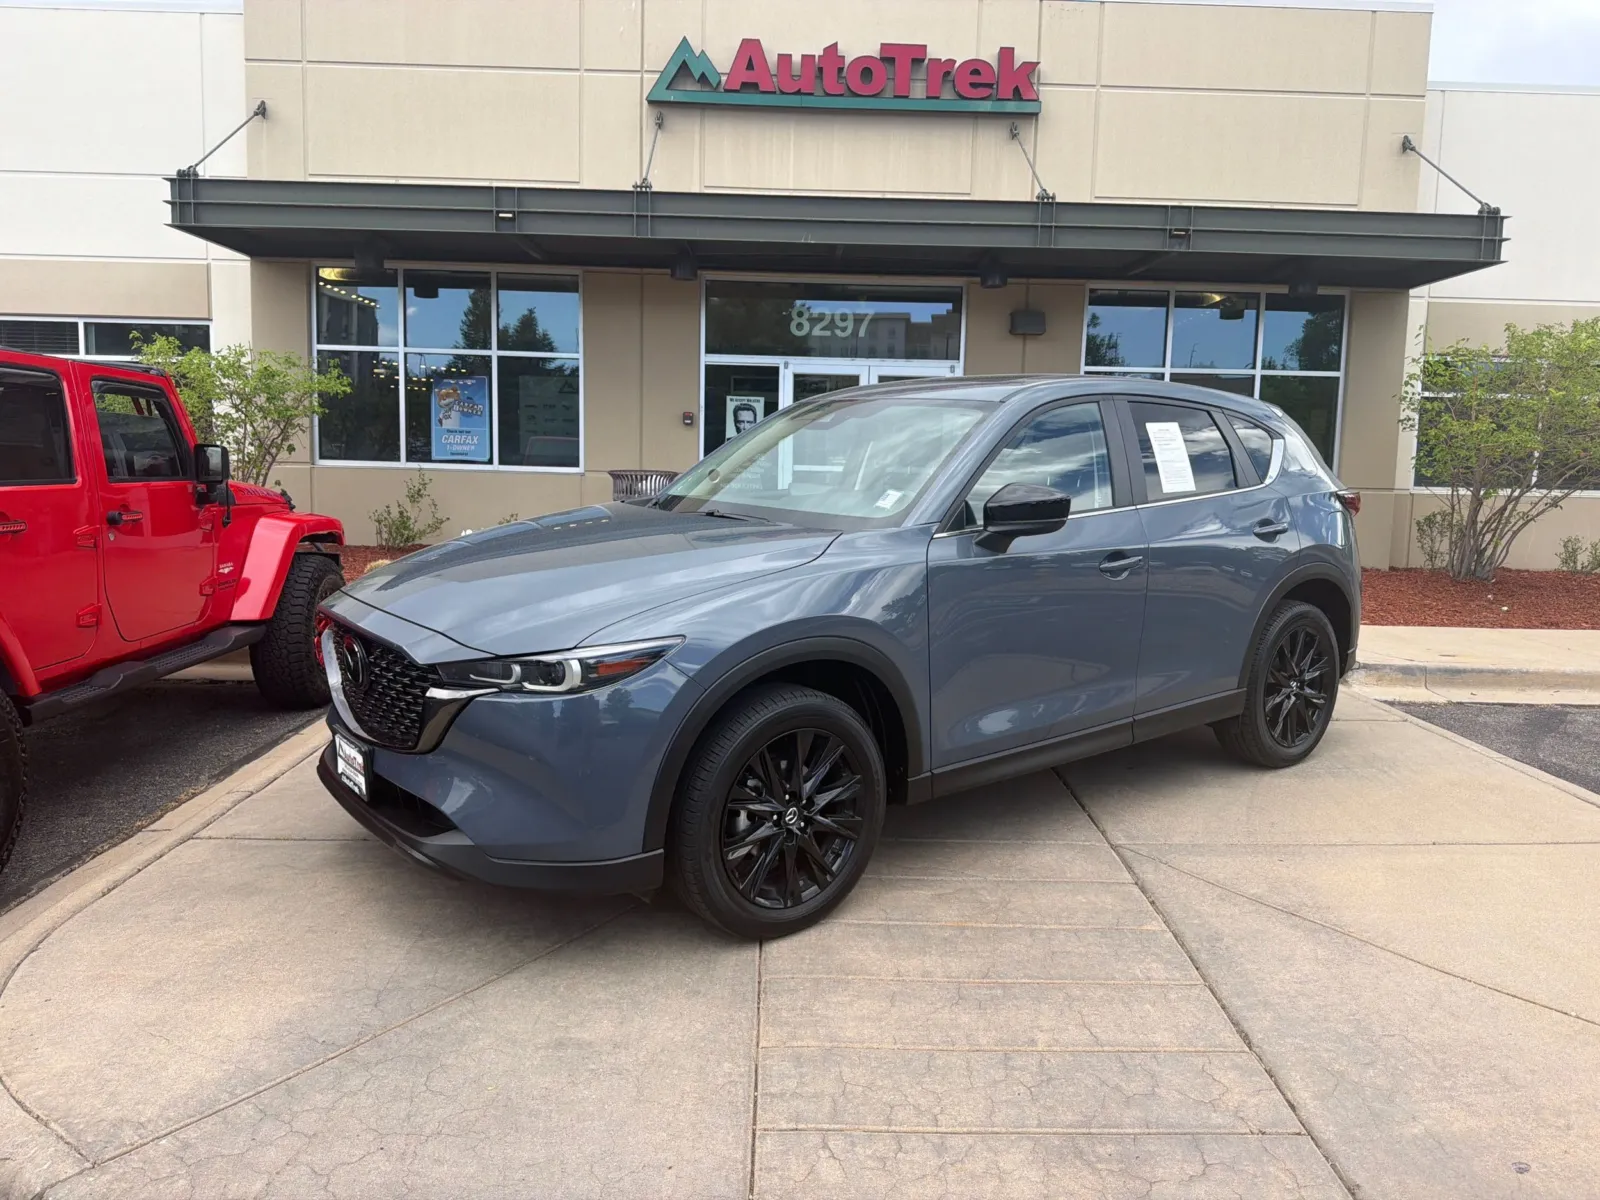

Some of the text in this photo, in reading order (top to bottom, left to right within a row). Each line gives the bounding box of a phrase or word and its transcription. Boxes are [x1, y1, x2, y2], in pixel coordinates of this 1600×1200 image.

[723, 38, 1041, 100] AutoTrek
[790, 306, 875, 337] 8297
[441, 434, 479, 445] CARFAX
